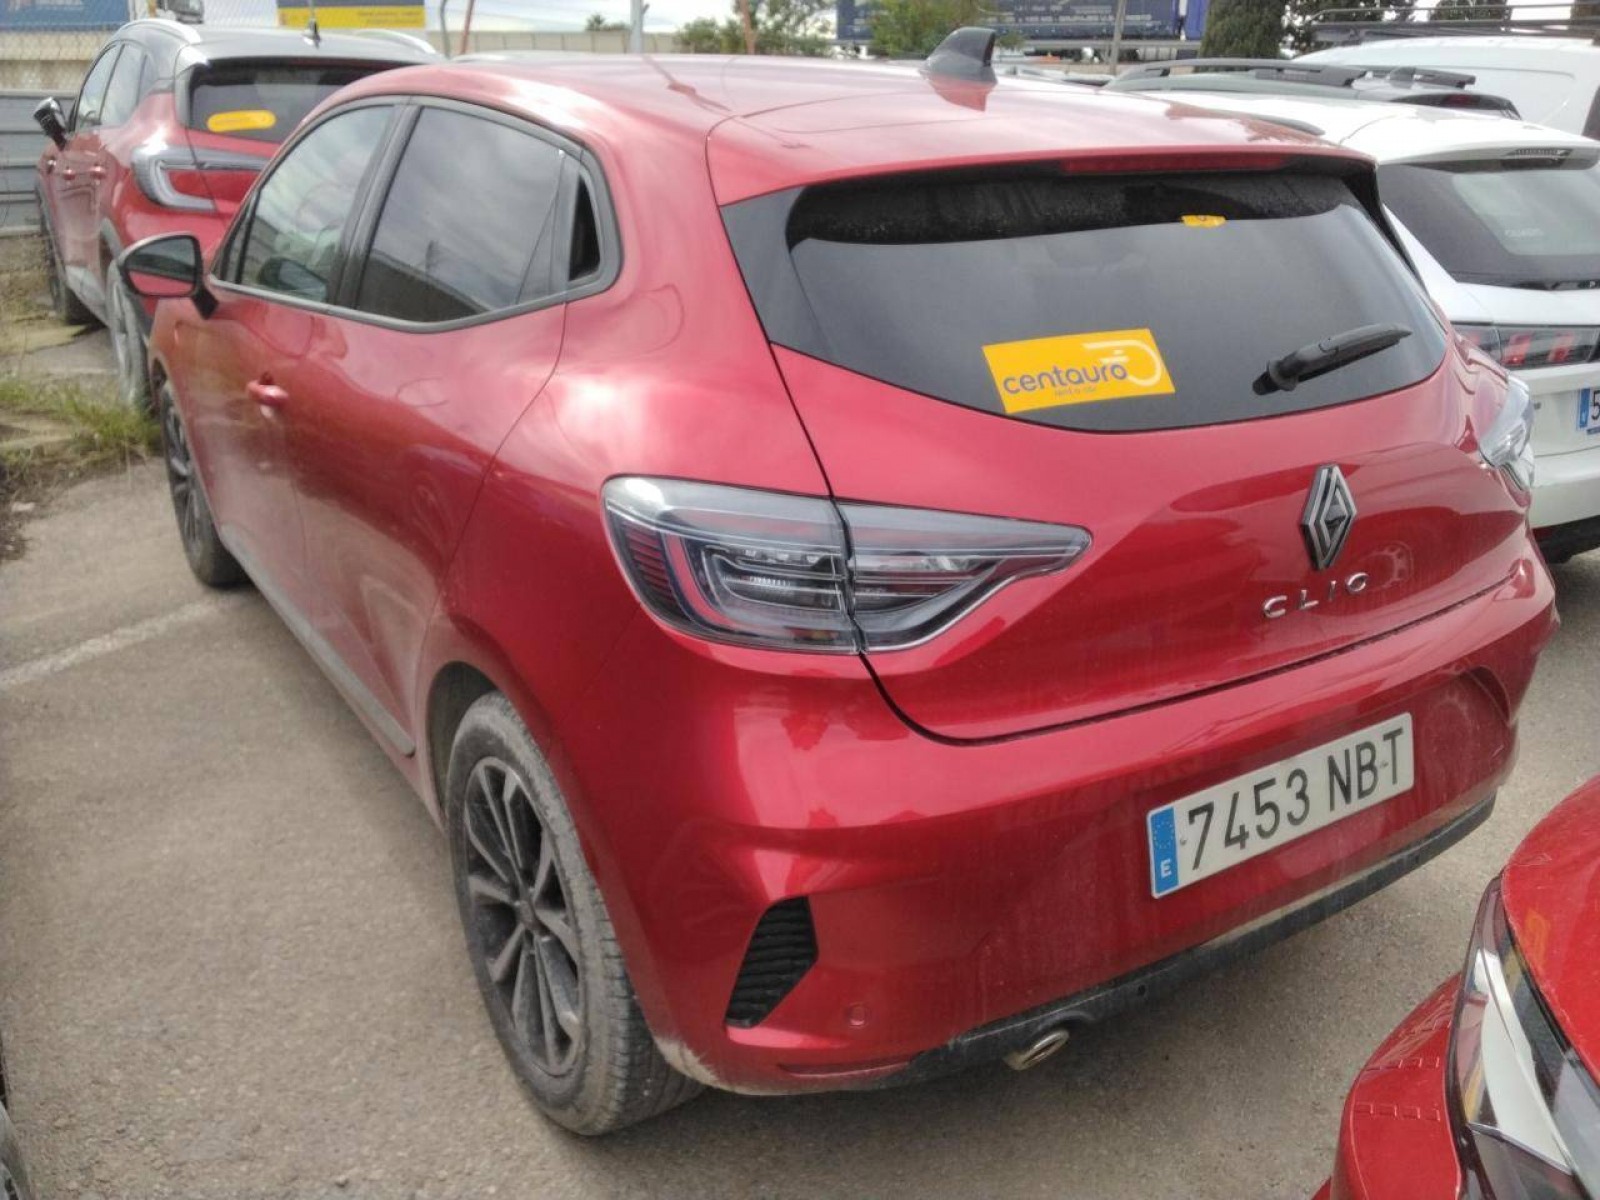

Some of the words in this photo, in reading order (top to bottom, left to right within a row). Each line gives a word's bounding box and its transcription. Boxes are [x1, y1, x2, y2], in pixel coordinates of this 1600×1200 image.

[1003, 363, 1128, 395] centauro
[1263, 572, 1368, 618] CLIO
[1188, 768, 1311, 871] 7453
[1326, 727, 1404, 812] NBT
[1160, 858, 1172, 878] E
